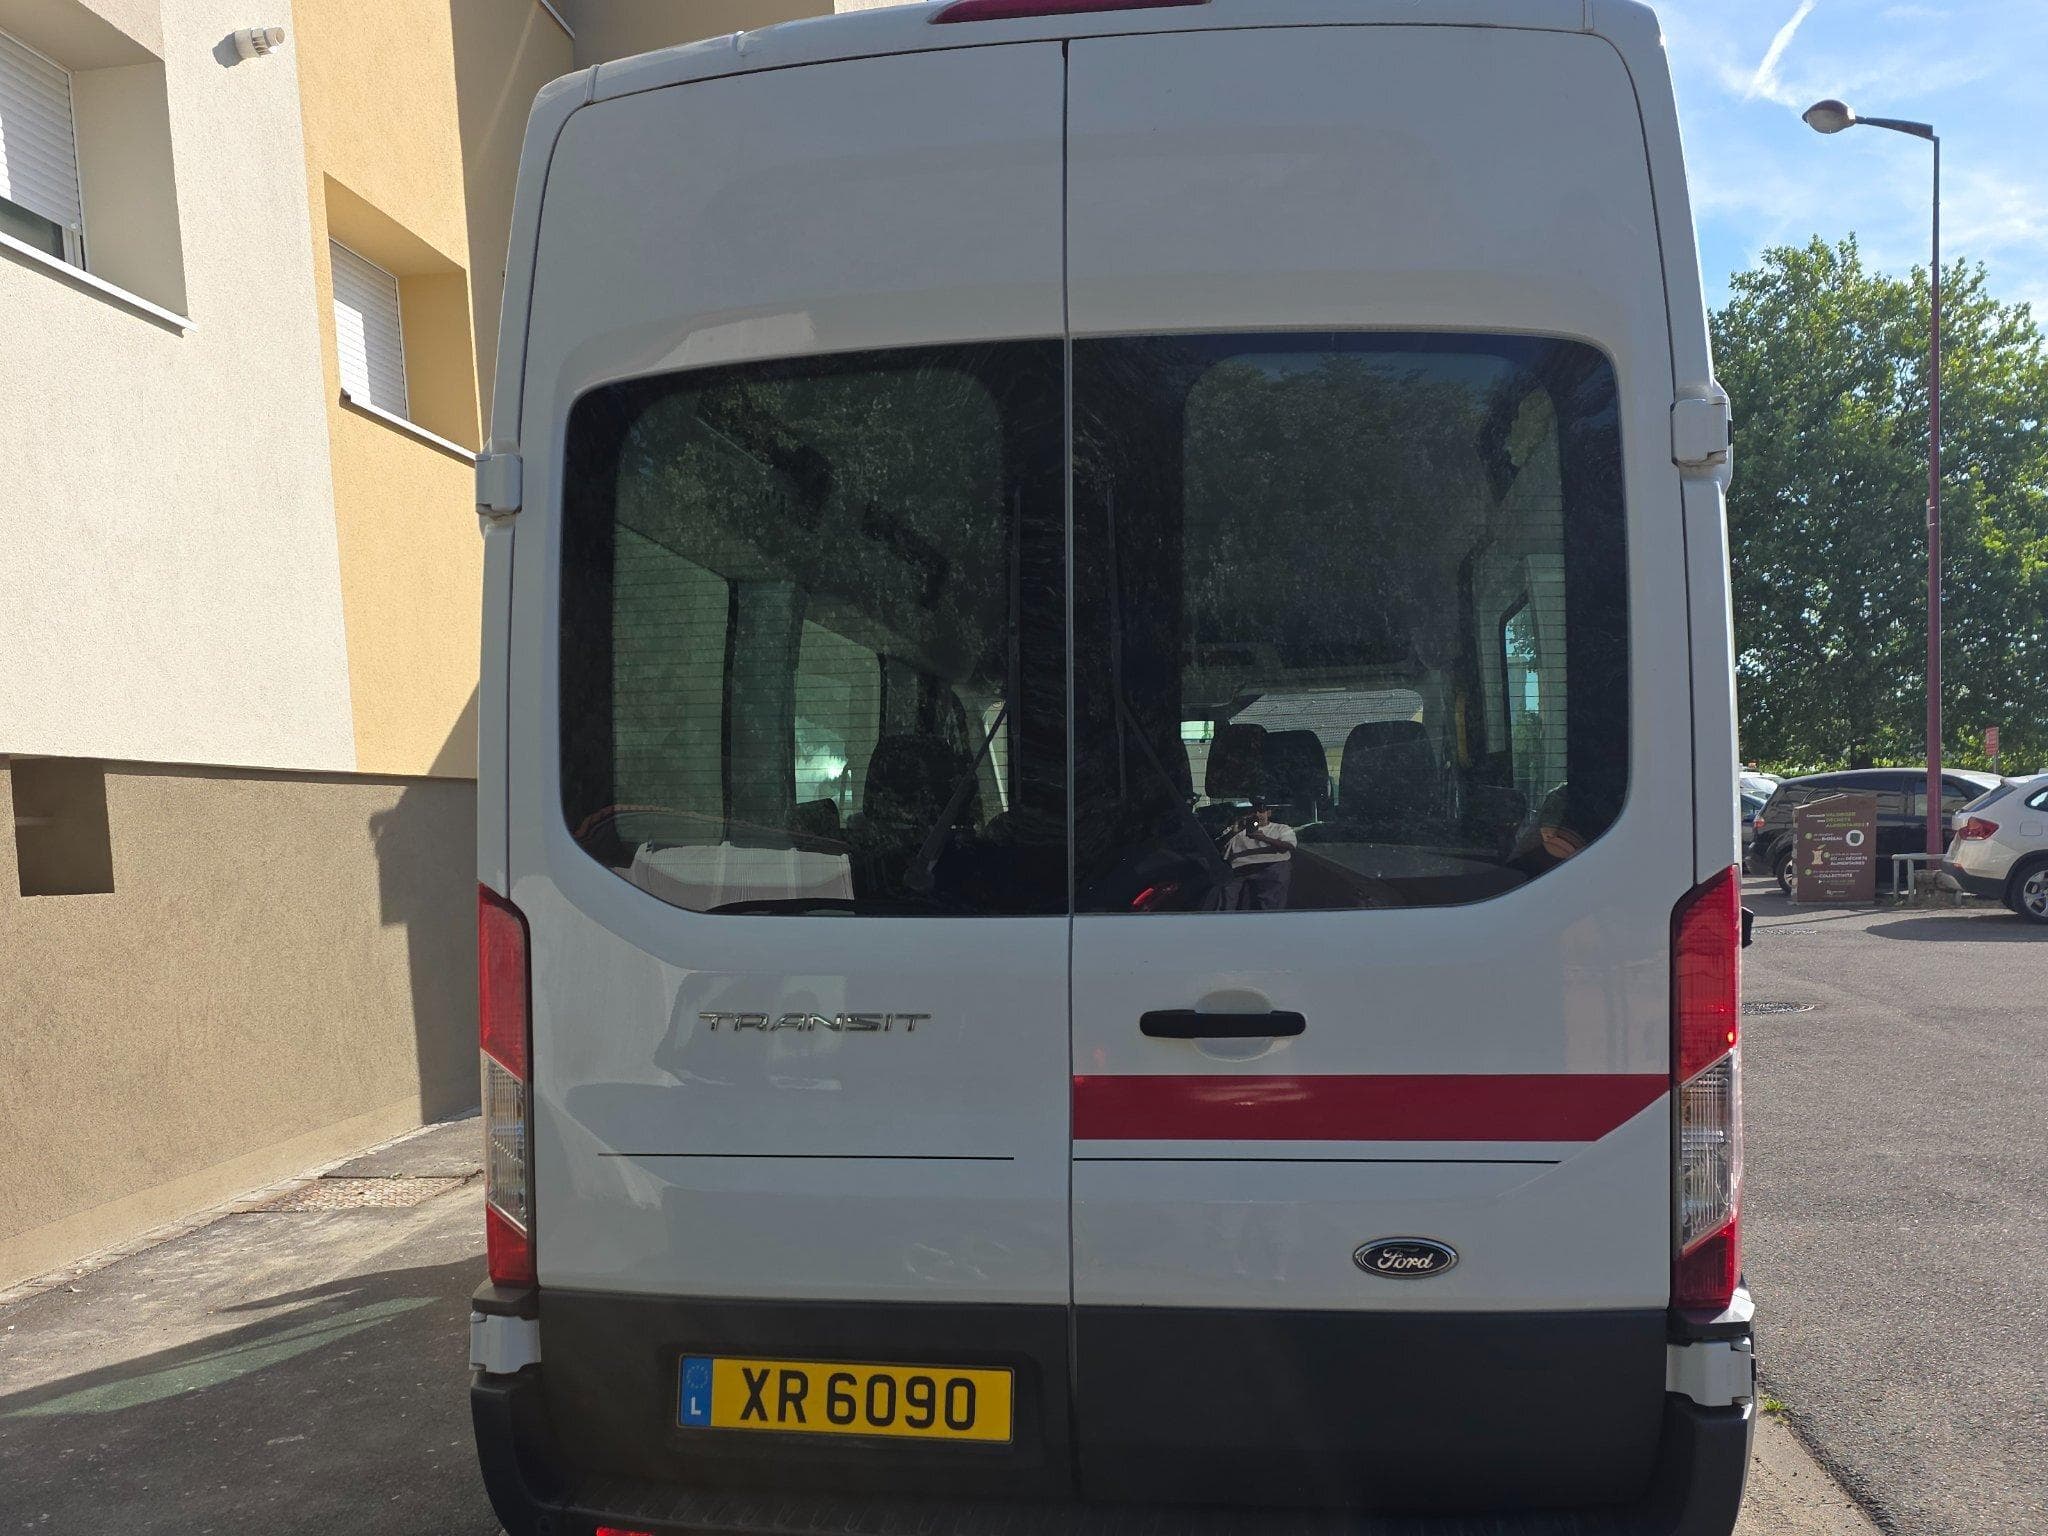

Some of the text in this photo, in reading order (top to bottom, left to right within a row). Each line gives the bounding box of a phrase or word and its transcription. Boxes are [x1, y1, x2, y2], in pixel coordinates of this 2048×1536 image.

[698, 1011, 932, 1032] TRANSIT
[1377, 1247, 1434, 1270] Ford
[690, 1396, 702, 1416] L
[739, 1367, 977, 1431] XR 6090
